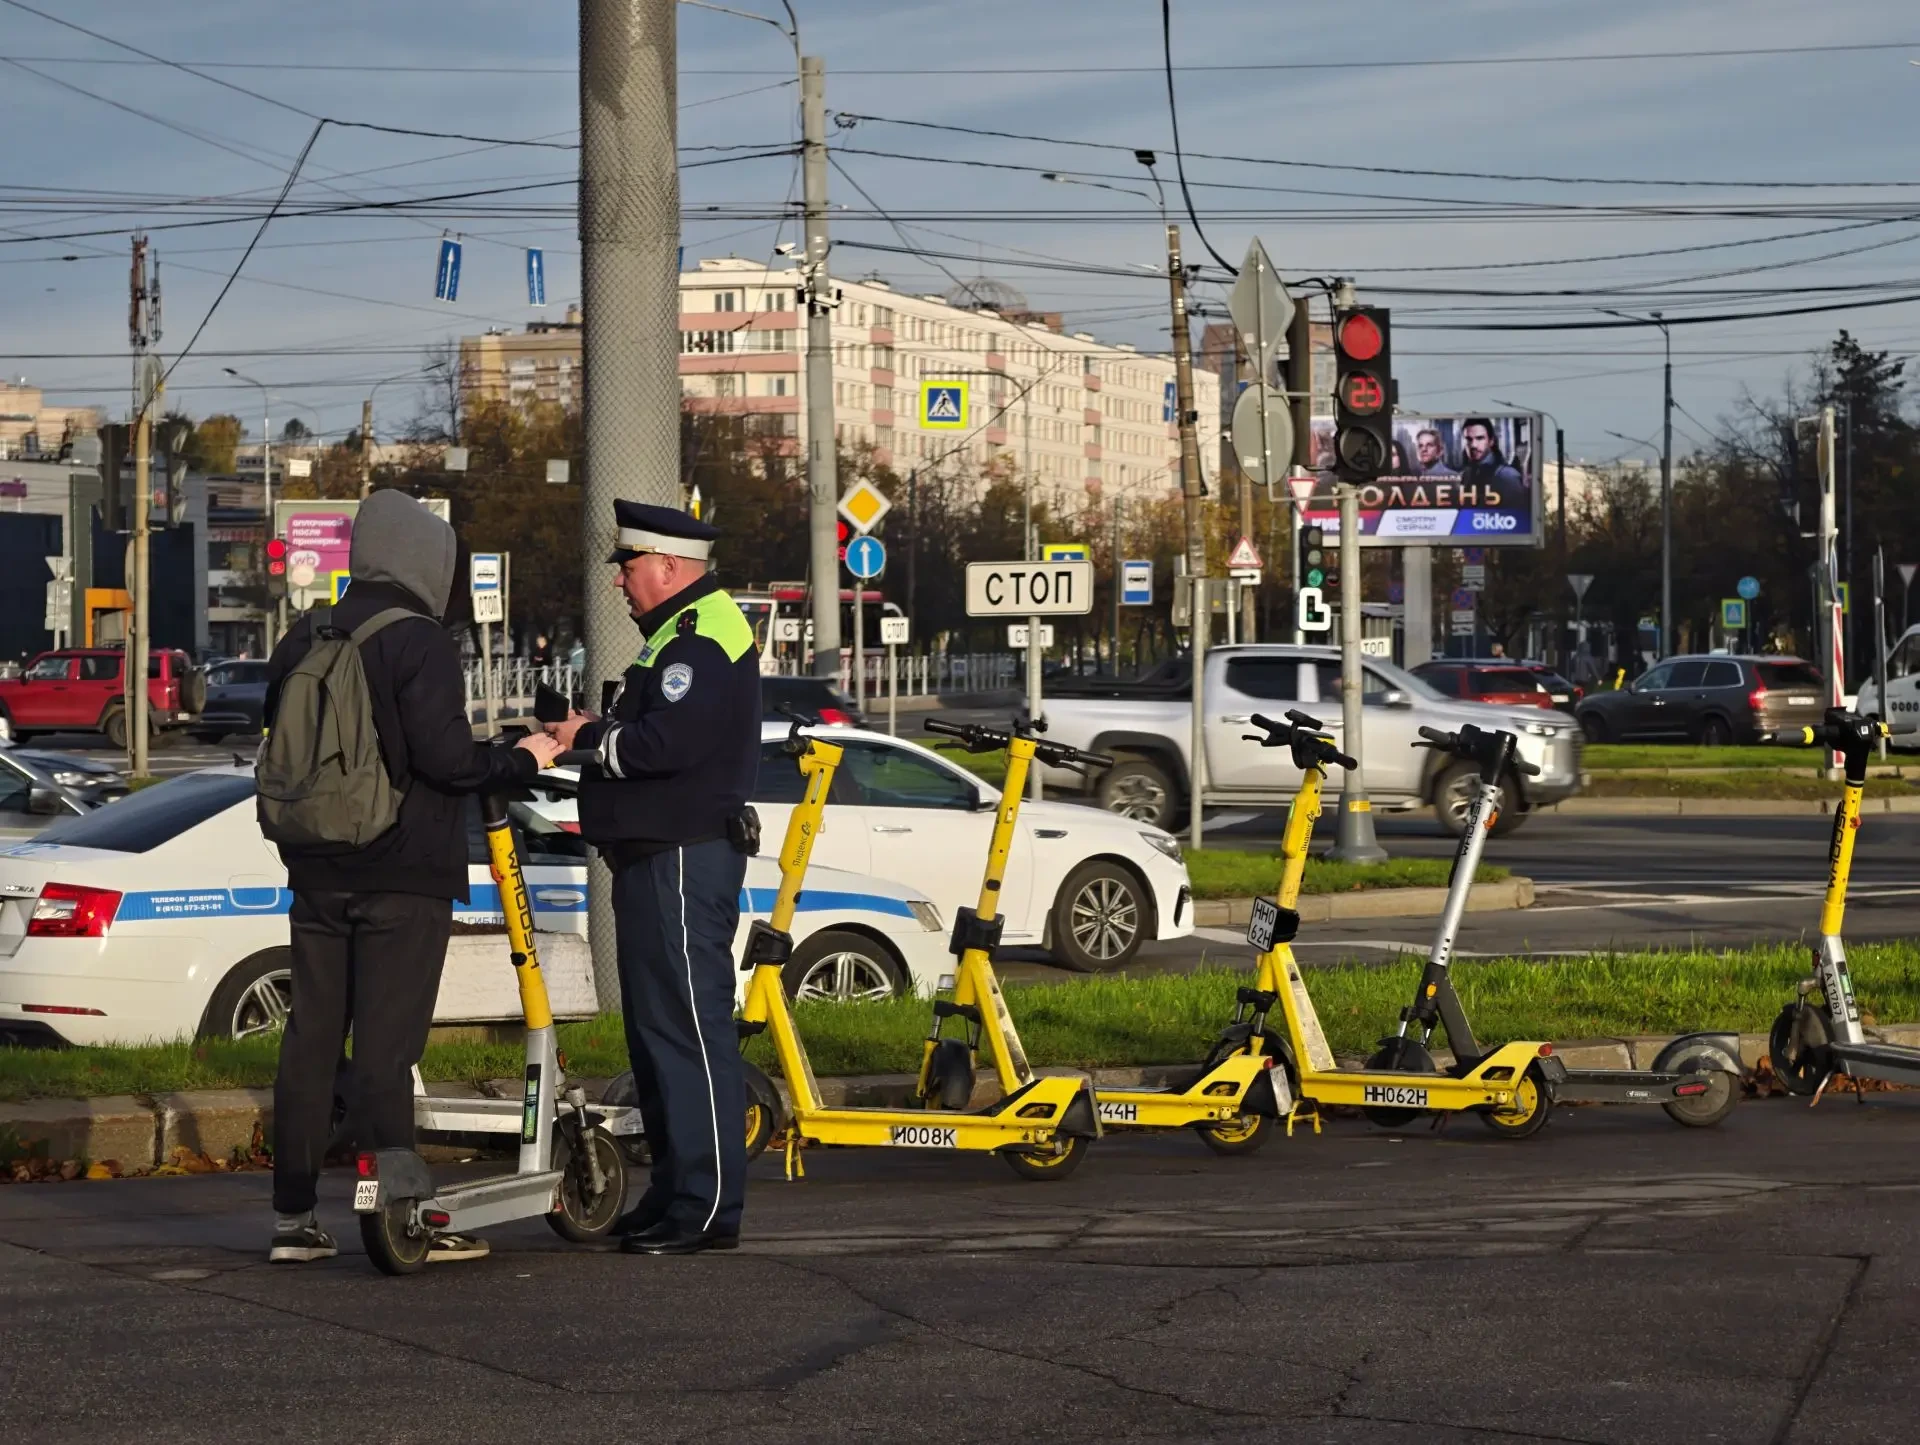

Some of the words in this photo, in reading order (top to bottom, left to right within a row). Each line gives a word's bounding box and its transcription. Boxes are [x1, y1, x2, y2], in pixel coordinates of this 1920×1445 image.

[1351, 377, 1381, 408] 23
[985, 571, 1072, 605] СТОП
[507, 849, 540, 970] WHOOSH
[1824, 972, 1843, 1016] AT1787
